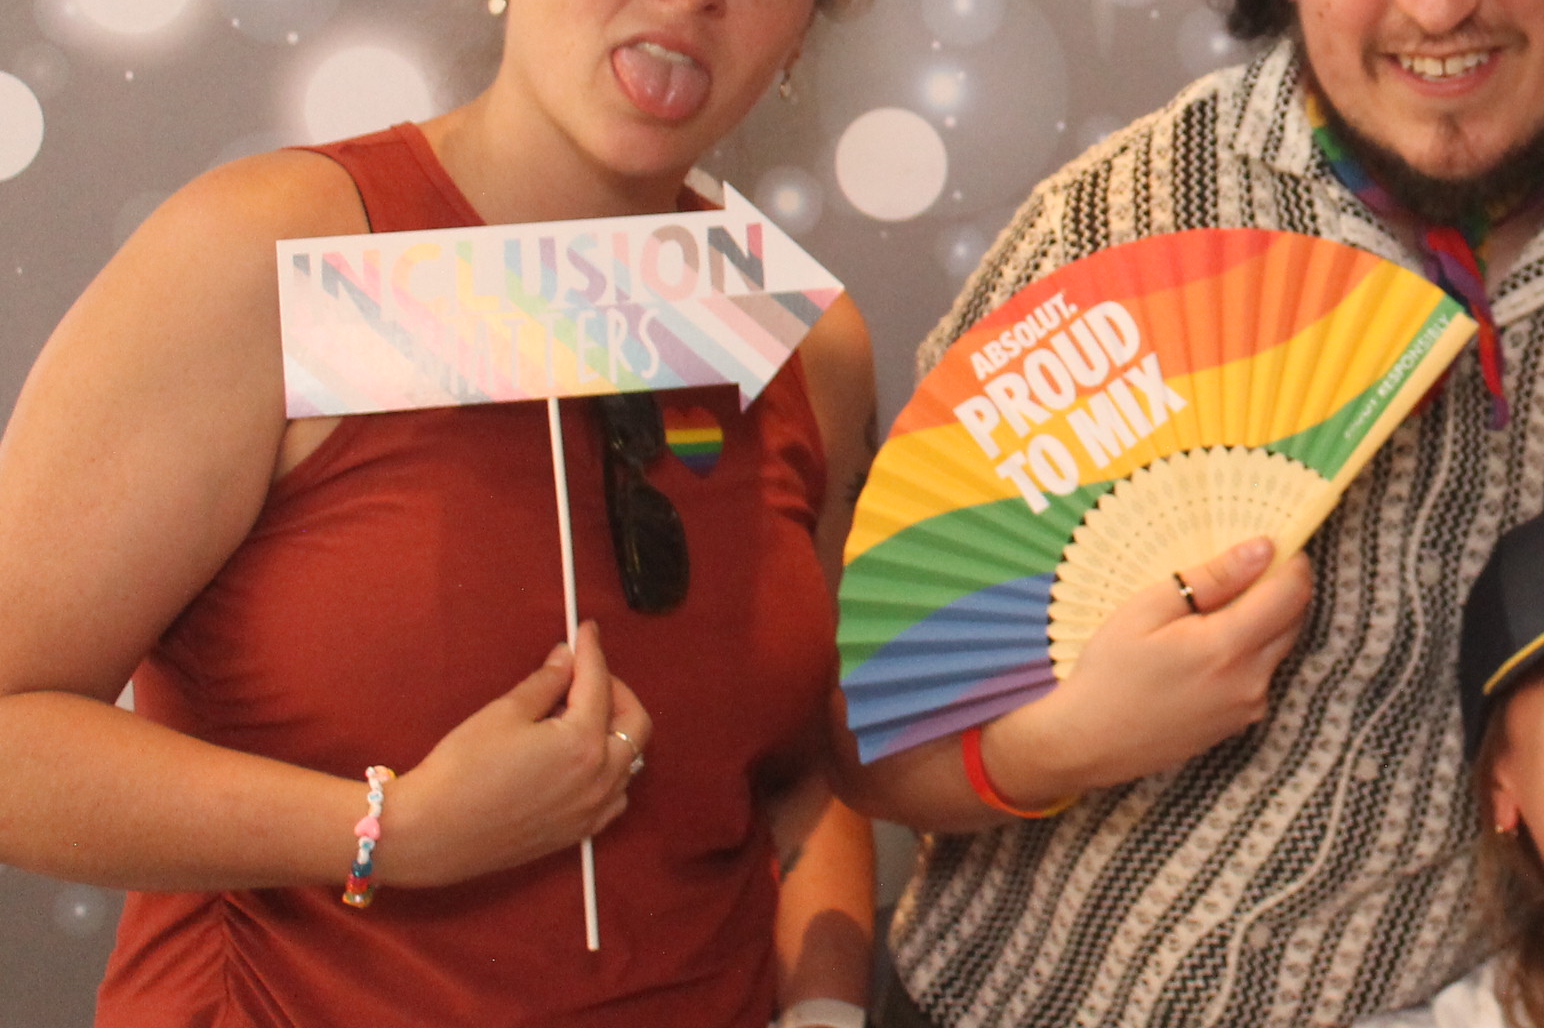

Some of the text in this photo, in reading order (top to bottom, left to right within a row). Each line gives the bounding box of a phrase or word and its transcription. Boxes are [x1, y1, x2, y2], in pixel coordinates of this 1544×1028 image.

[292, 222, 765, 325] INCLUSION
[414, 307, 662, 394] MATTERS
[953, 300, 1141, 460] PROUD
[970, 291, 1079, 380] ABSOLUT.
[995, 351, 1188, 515] TO MIX
